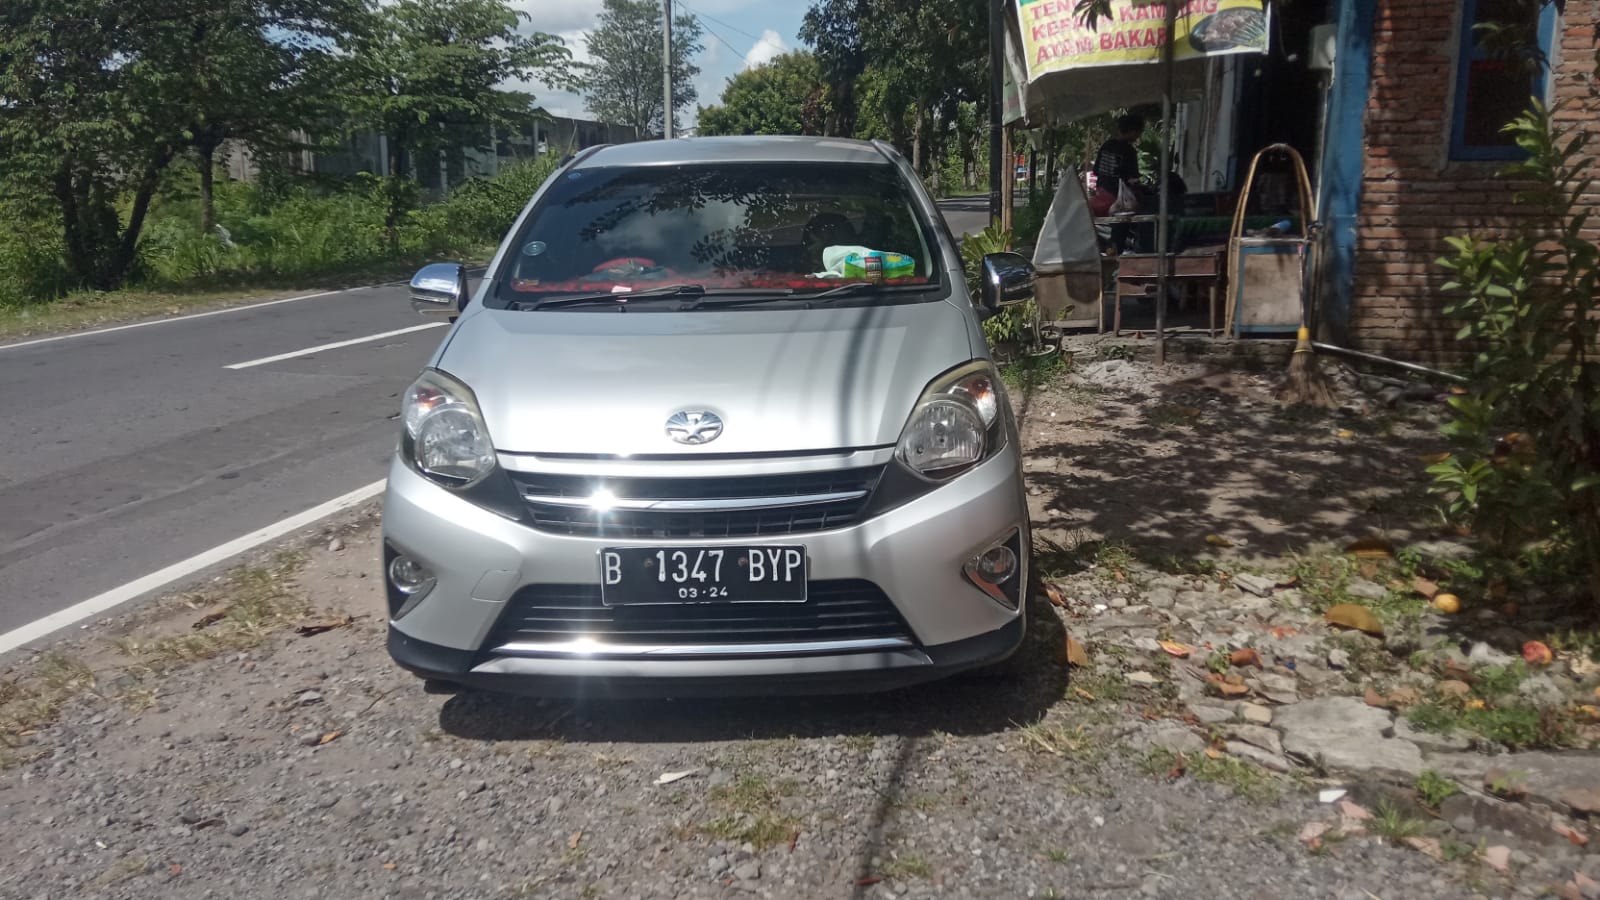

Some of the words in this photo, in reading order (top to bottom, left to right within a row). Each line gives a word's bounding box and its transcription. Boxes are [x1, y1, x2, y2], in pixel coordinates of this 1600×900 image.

[1031, 14, 1114, 42] KEPAA
[1119, 0, 1218, 22] KAMING
[605, 552, 622, 585] B
[656, 550, 725, 583] 1347
[749, 549, 801, 582] BYP
